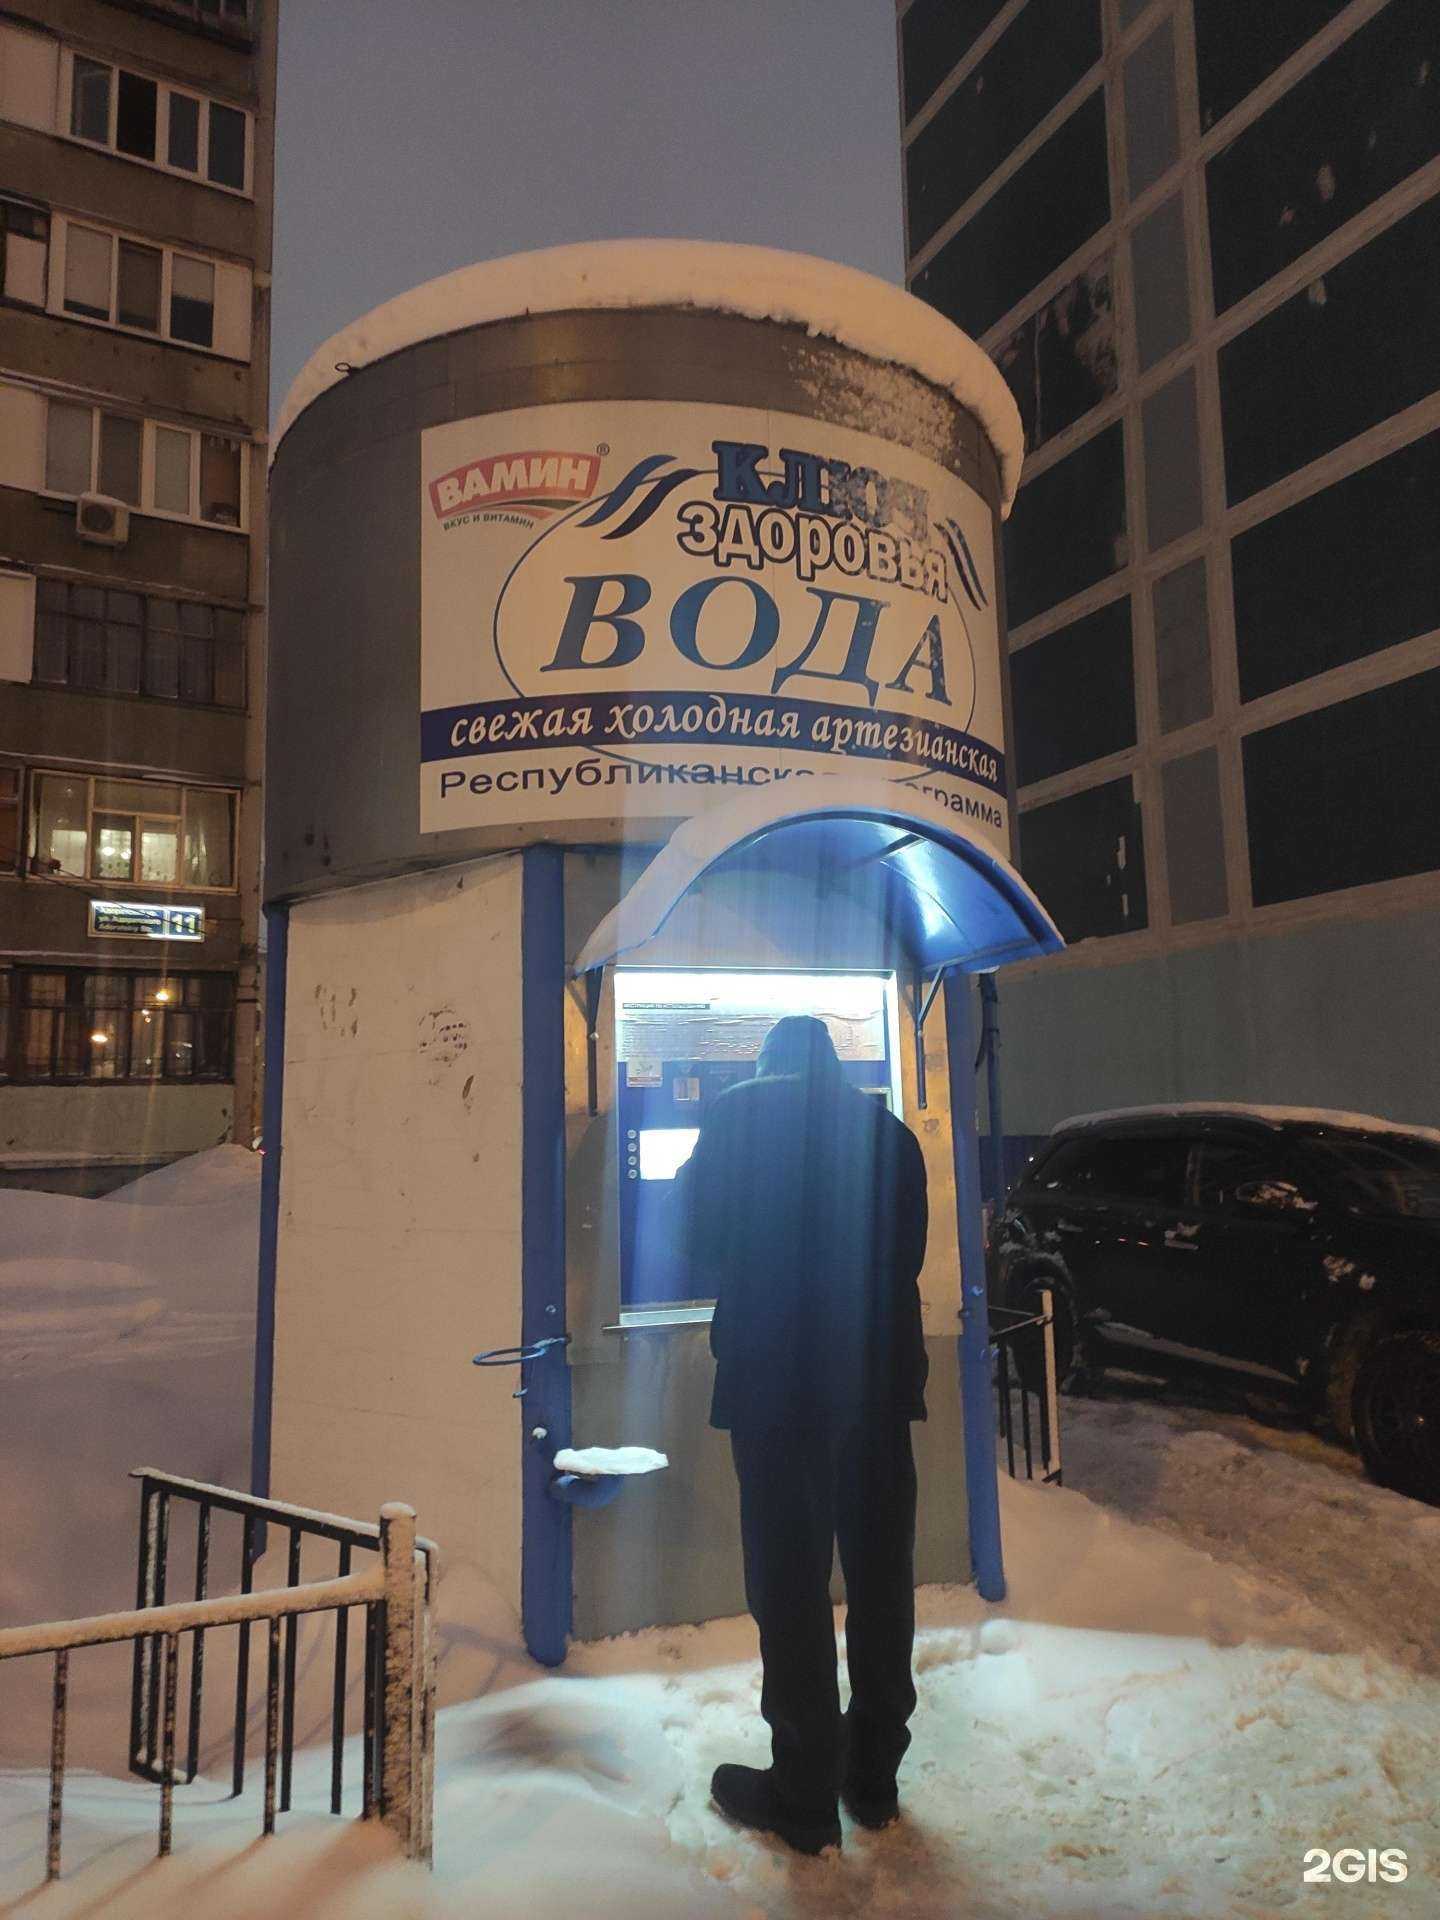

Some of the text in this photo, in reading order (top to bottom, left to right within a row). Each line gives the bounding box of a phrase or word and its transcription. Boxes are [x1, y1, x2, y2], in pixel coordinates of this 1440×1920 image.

[436, 457, 592, 512] ВАМИН
[443, 514, 471, 531] ВКУС
[473, 513, 481, 522] И
[539, 574, 953, 707] ВОДА
[449, 694, 999, 784] свежая холодная артезианская
[440, 758, 840, 799] Республиканск
